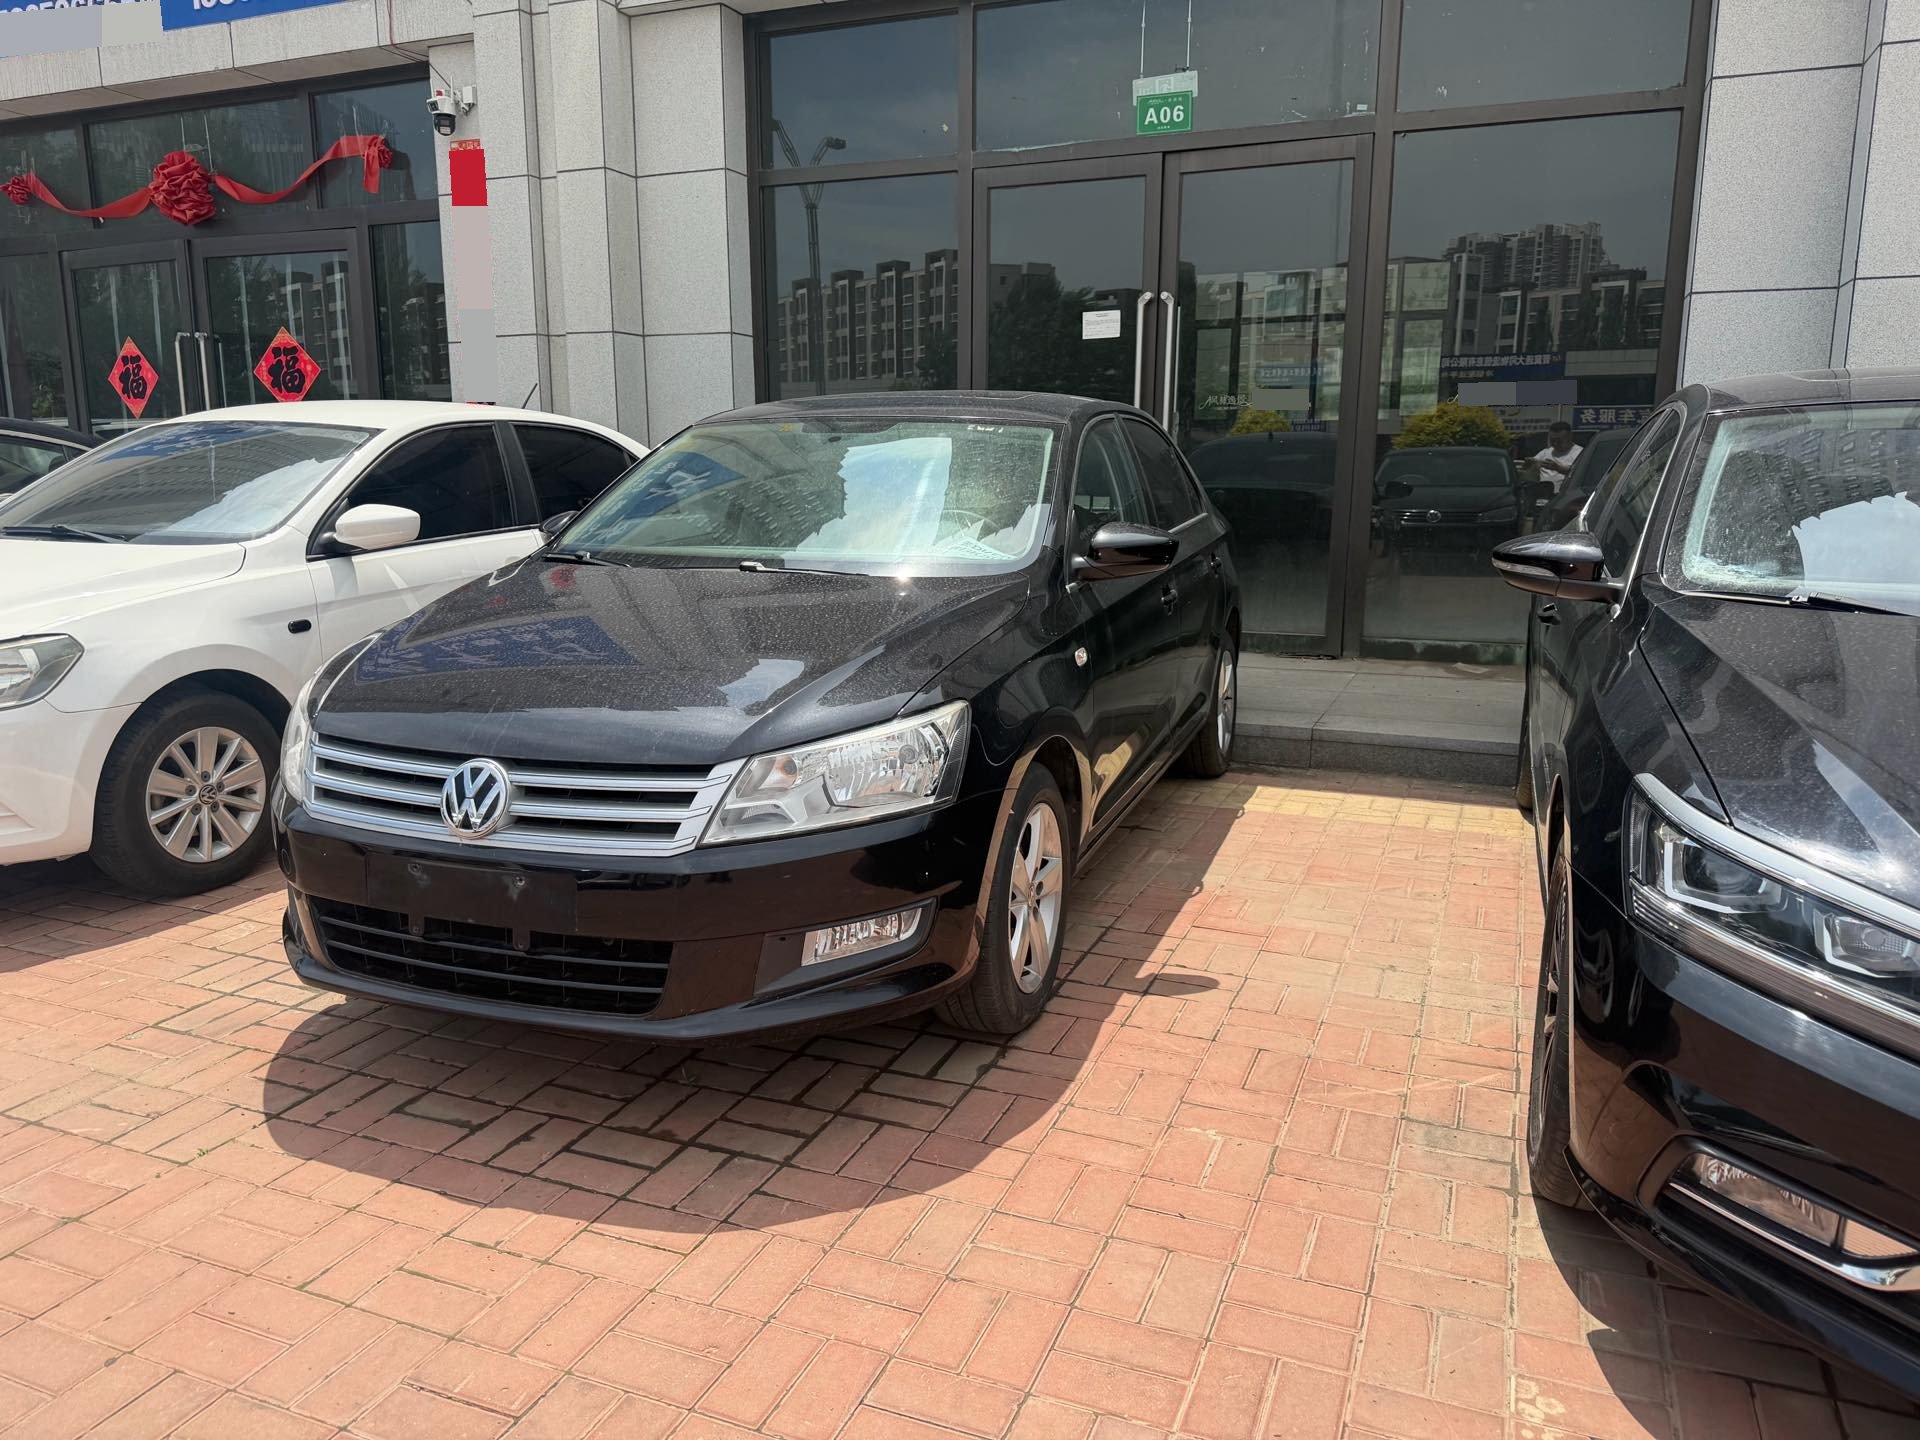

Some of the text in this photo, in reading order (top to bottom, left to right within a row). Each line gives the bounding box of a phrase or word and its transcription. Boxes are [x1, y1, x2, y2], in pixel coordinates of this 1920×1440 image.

[1144, 105, 1185, 125] A06
[118, 354, 148, 400] 福
[268, 346, 306, 394] 福
